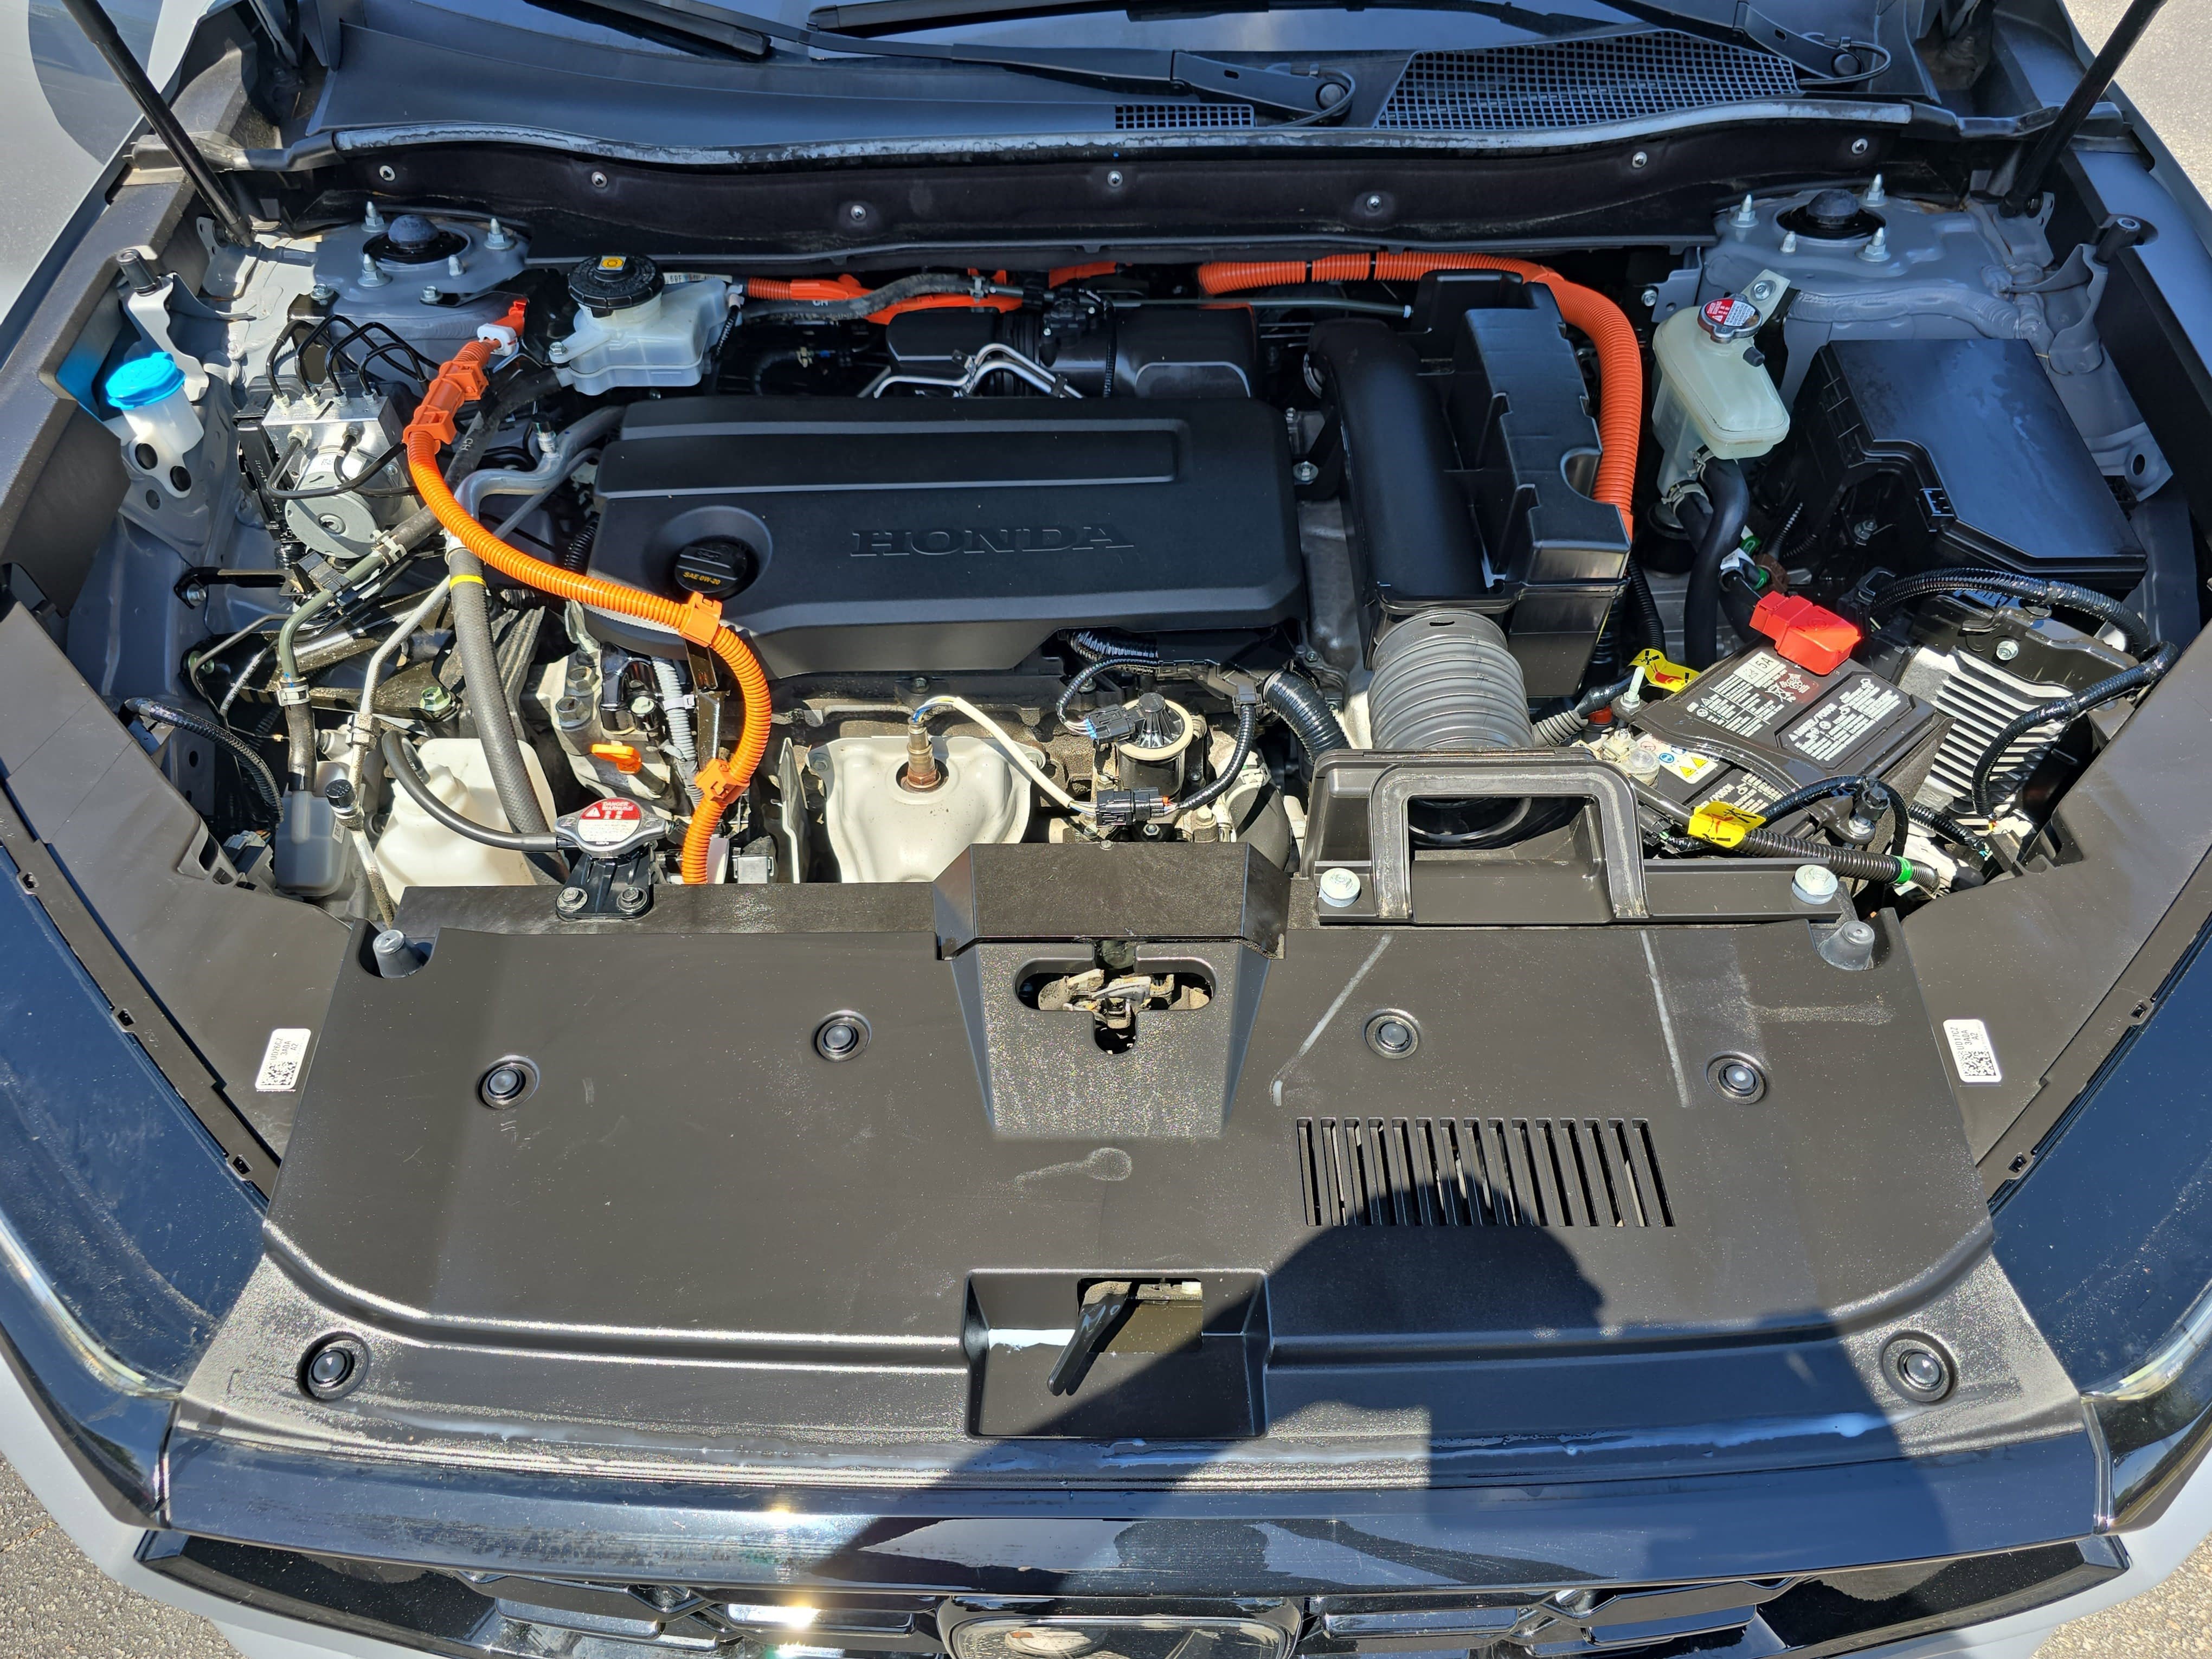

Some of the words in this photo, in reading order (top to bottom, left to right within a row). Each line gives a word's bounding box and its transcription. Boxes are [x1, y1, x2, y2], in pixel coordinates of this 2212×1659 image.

[460, 438, 473, 451] CH
[850, 526, 1135, 557] HONDA
[683, 571, 699, 580] SAE
[699, 575, 721, 585] 0W-20
[1756, 657, 1773, 668] 5A
